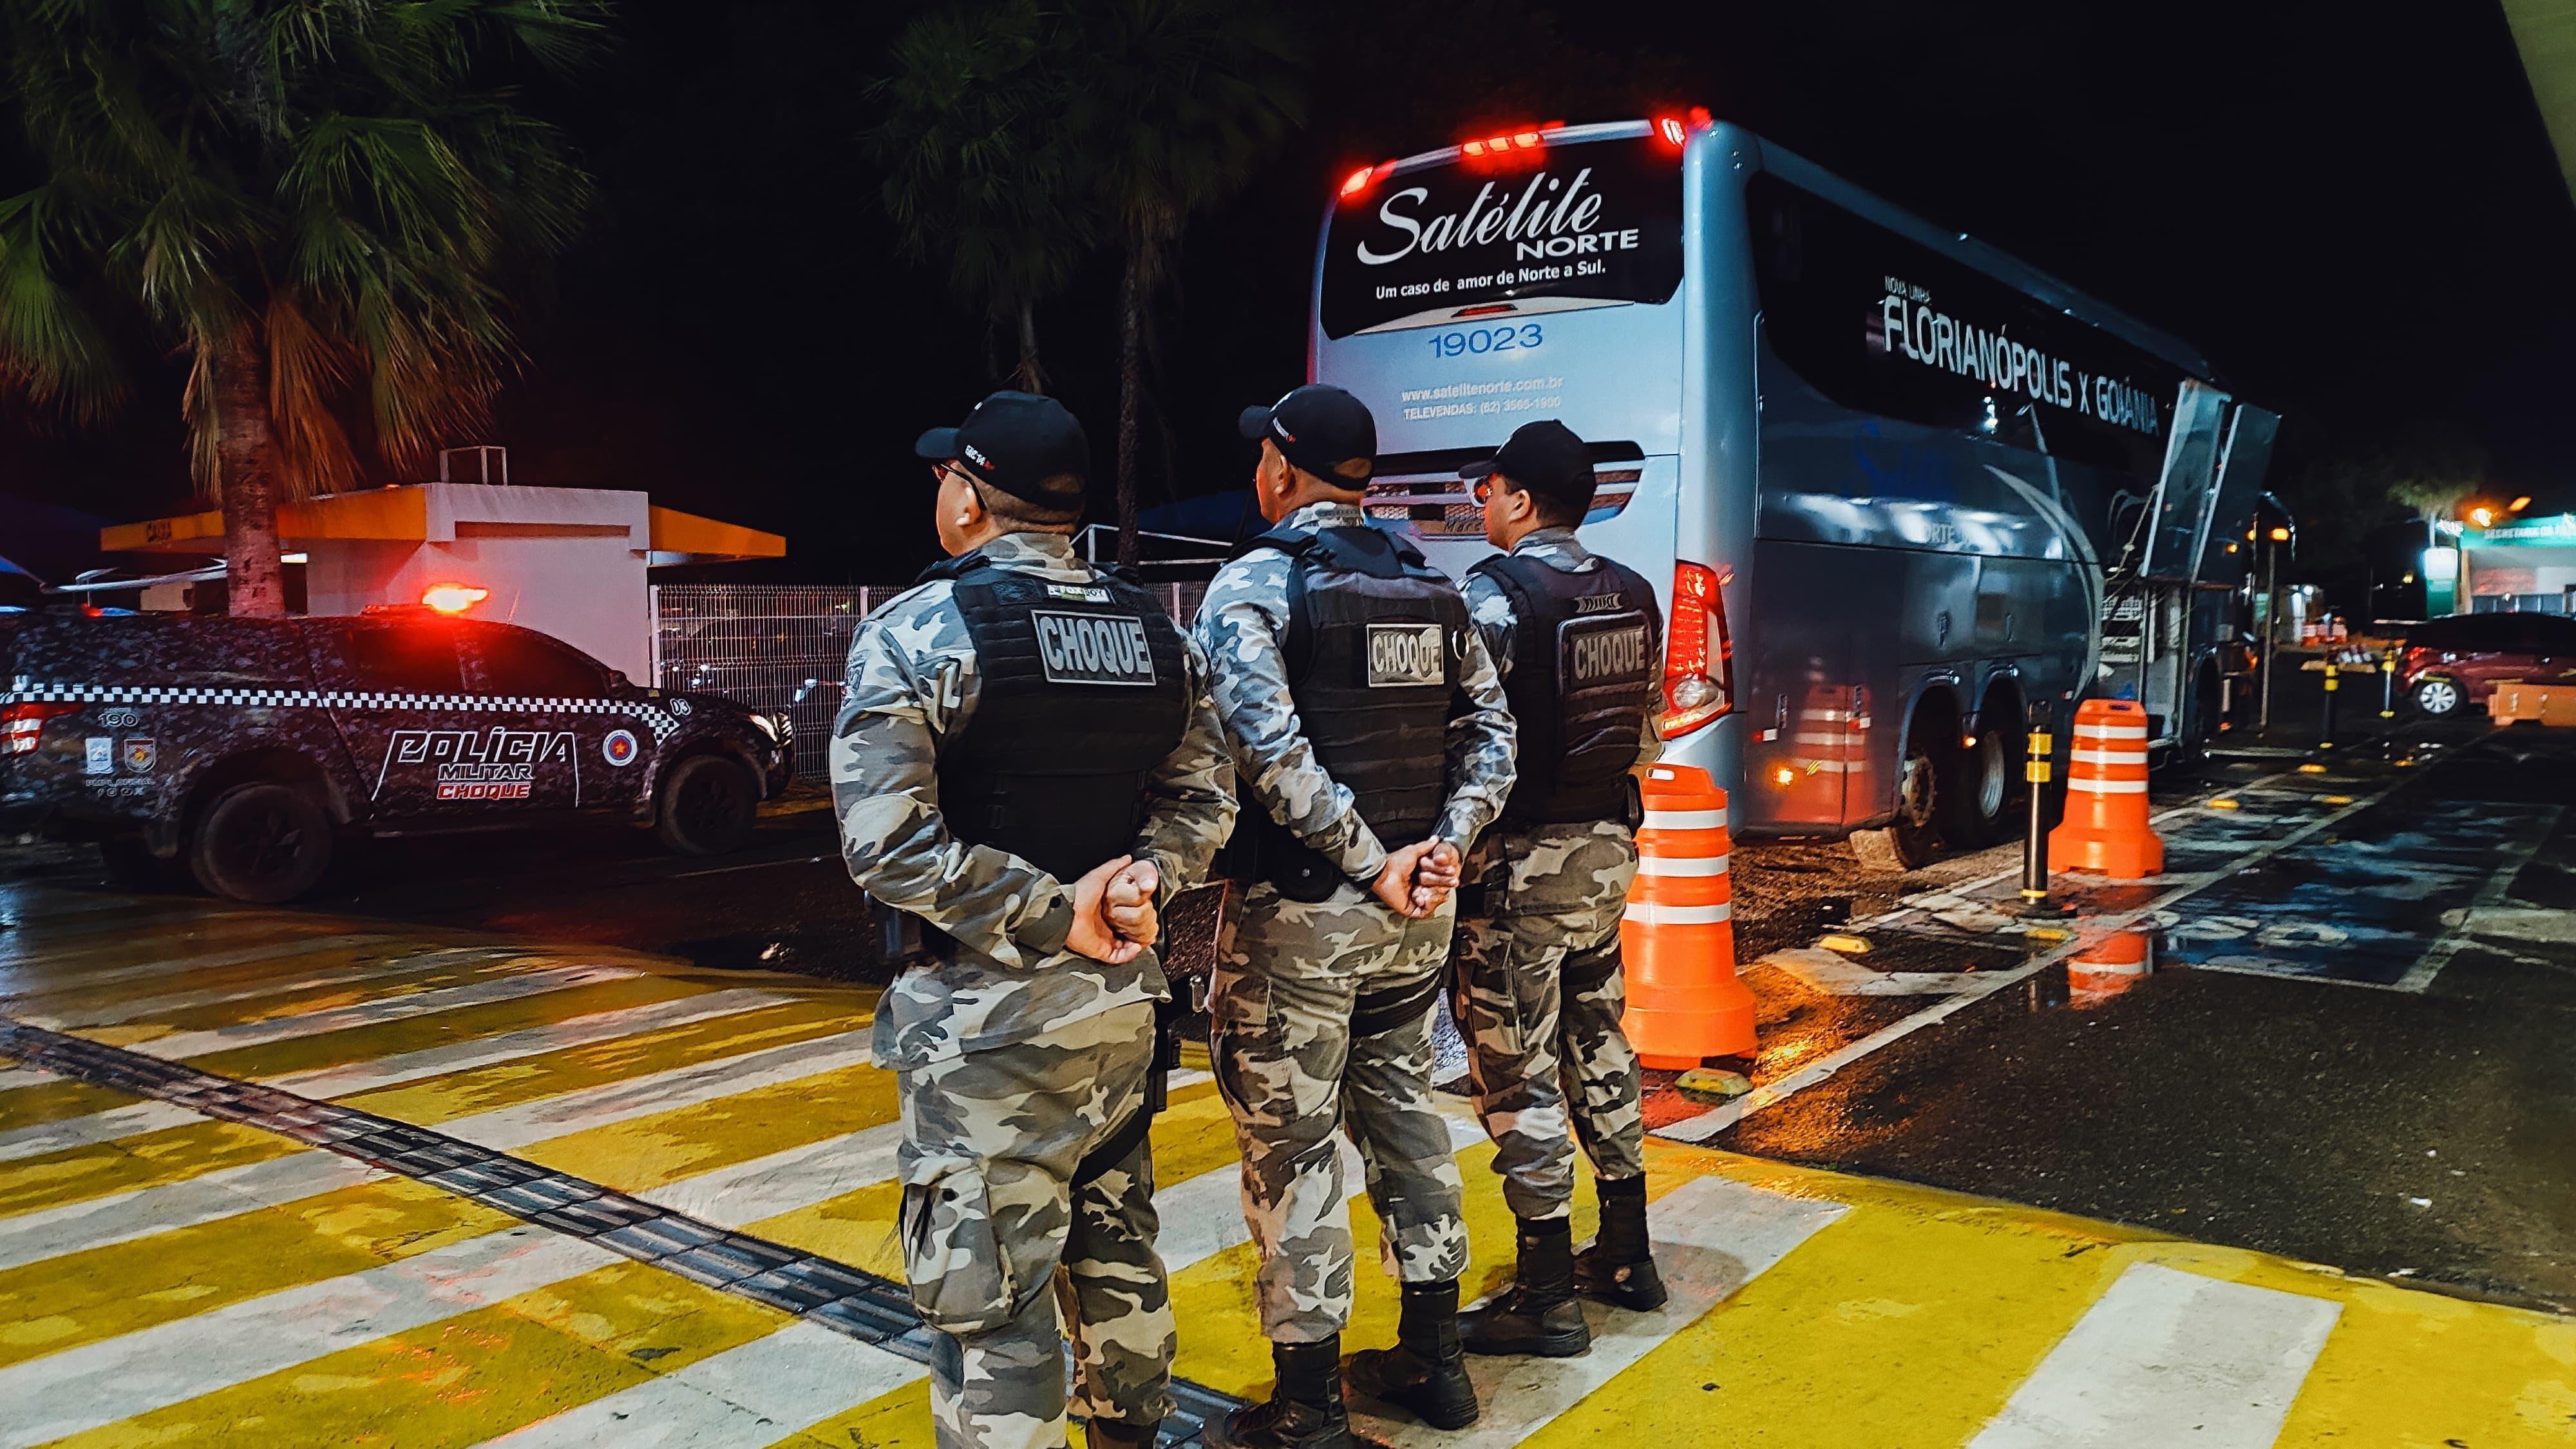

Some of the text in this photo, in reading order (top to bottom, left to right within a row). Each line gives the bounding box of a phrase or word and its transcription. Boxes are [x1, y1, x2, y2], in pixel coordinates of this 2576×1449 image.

[1357, 167, 1602, 265] Satélite
[1516, 228, 1639, 261] NORTE
[1376, 258, 1605, 299] Um caso de amor de Norte a Sul.
[1885, 276, 1907, 297] NOVA
[1428, 323, 1543, 358] 19023
[1884, 294, 2072, 408] FLORIANÓPOLIS
[2096, 375, 2159, 437] GOIÂNIA
[1401, 376, 1564, 402] www.satelitenorte.com.br
[1404, 402, 1476, 420] TELEVENDAS:
[1039, 616, 1151, 676] CHOQUE
[1372, 634, 1440, 674] CHOQUE
[1575, 628, 1645, 680] CHOQUE
[98, 712, 138, 728] 190
[388, 726, 576, 764] POLÍCIA
[438, 762, 535, 781] MILITAR
[437, 782, 531, 800] CHOQUE
